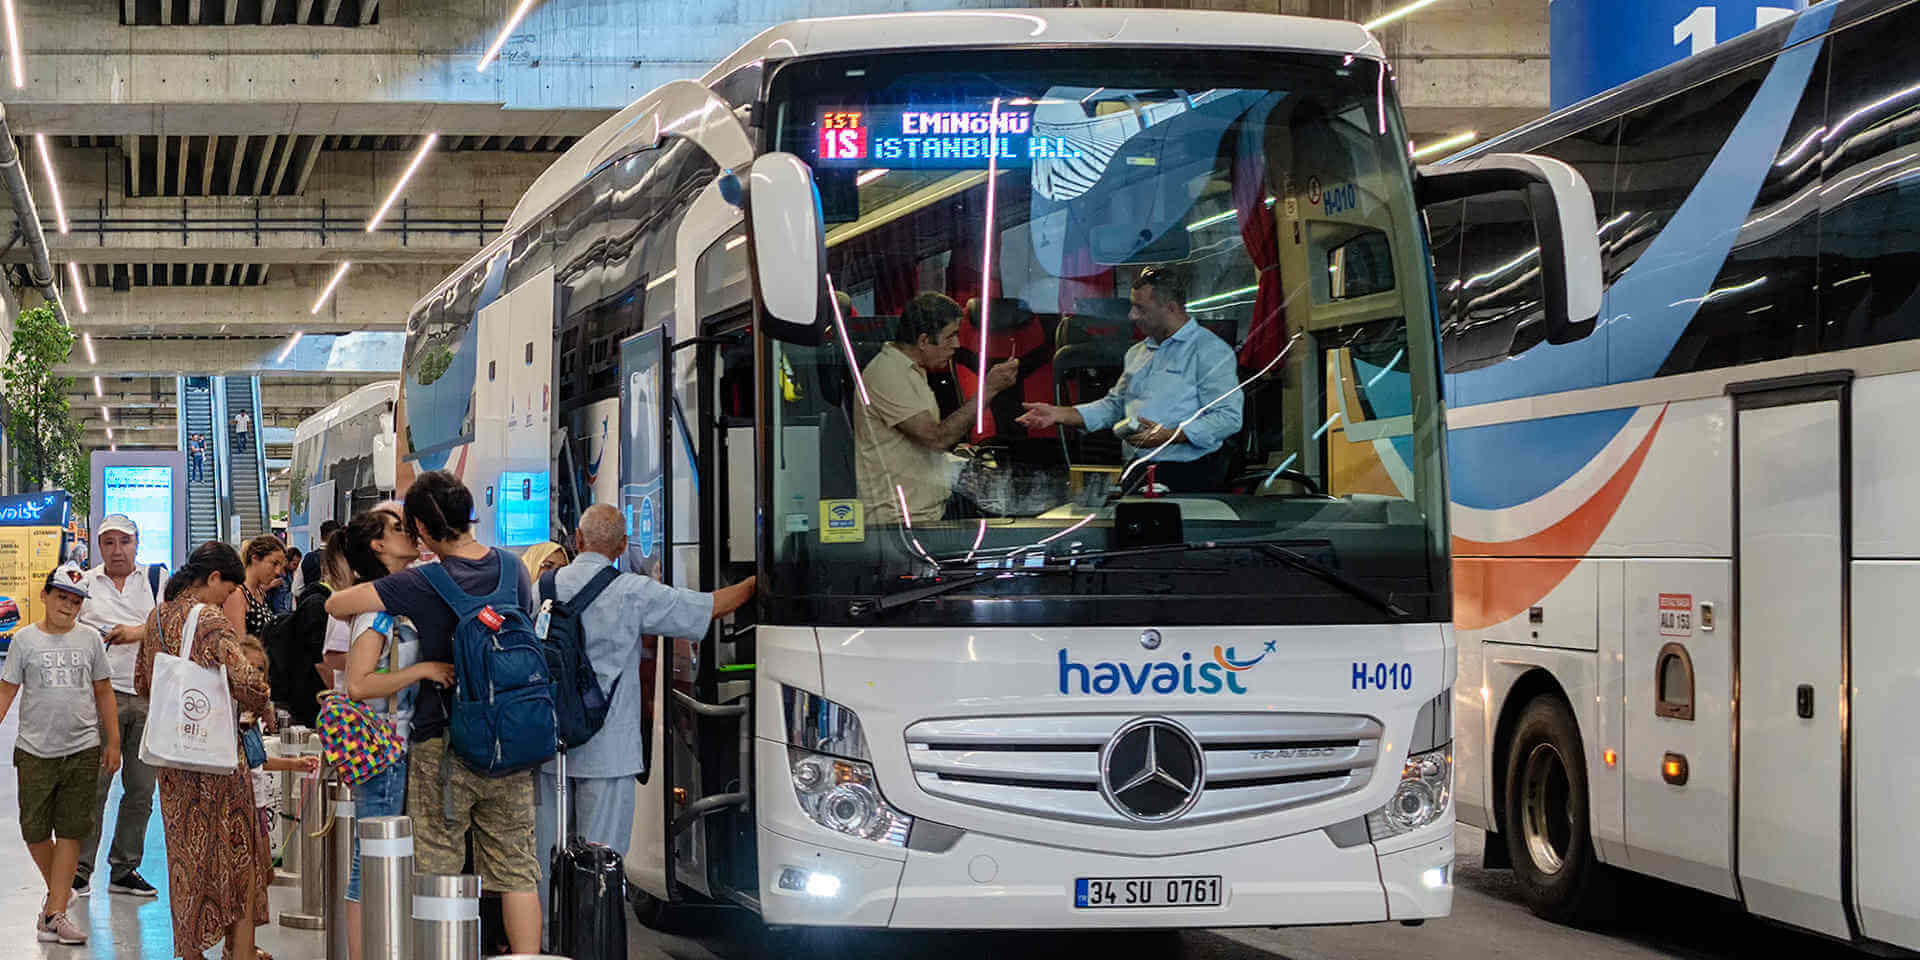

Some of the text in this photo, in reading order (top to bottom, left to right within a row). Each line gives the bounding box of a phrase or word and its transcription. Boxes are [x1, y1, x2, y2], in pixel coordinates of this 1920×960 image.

[1323, 184, 1355, 216] H-010
[1676, 614, 1690, 630] 153
[1058, 645, 1248, 695] havaist
[1352, 663, 1412, 690] H-010
[1090, 880, 1217, 904] 34 SU 0761
